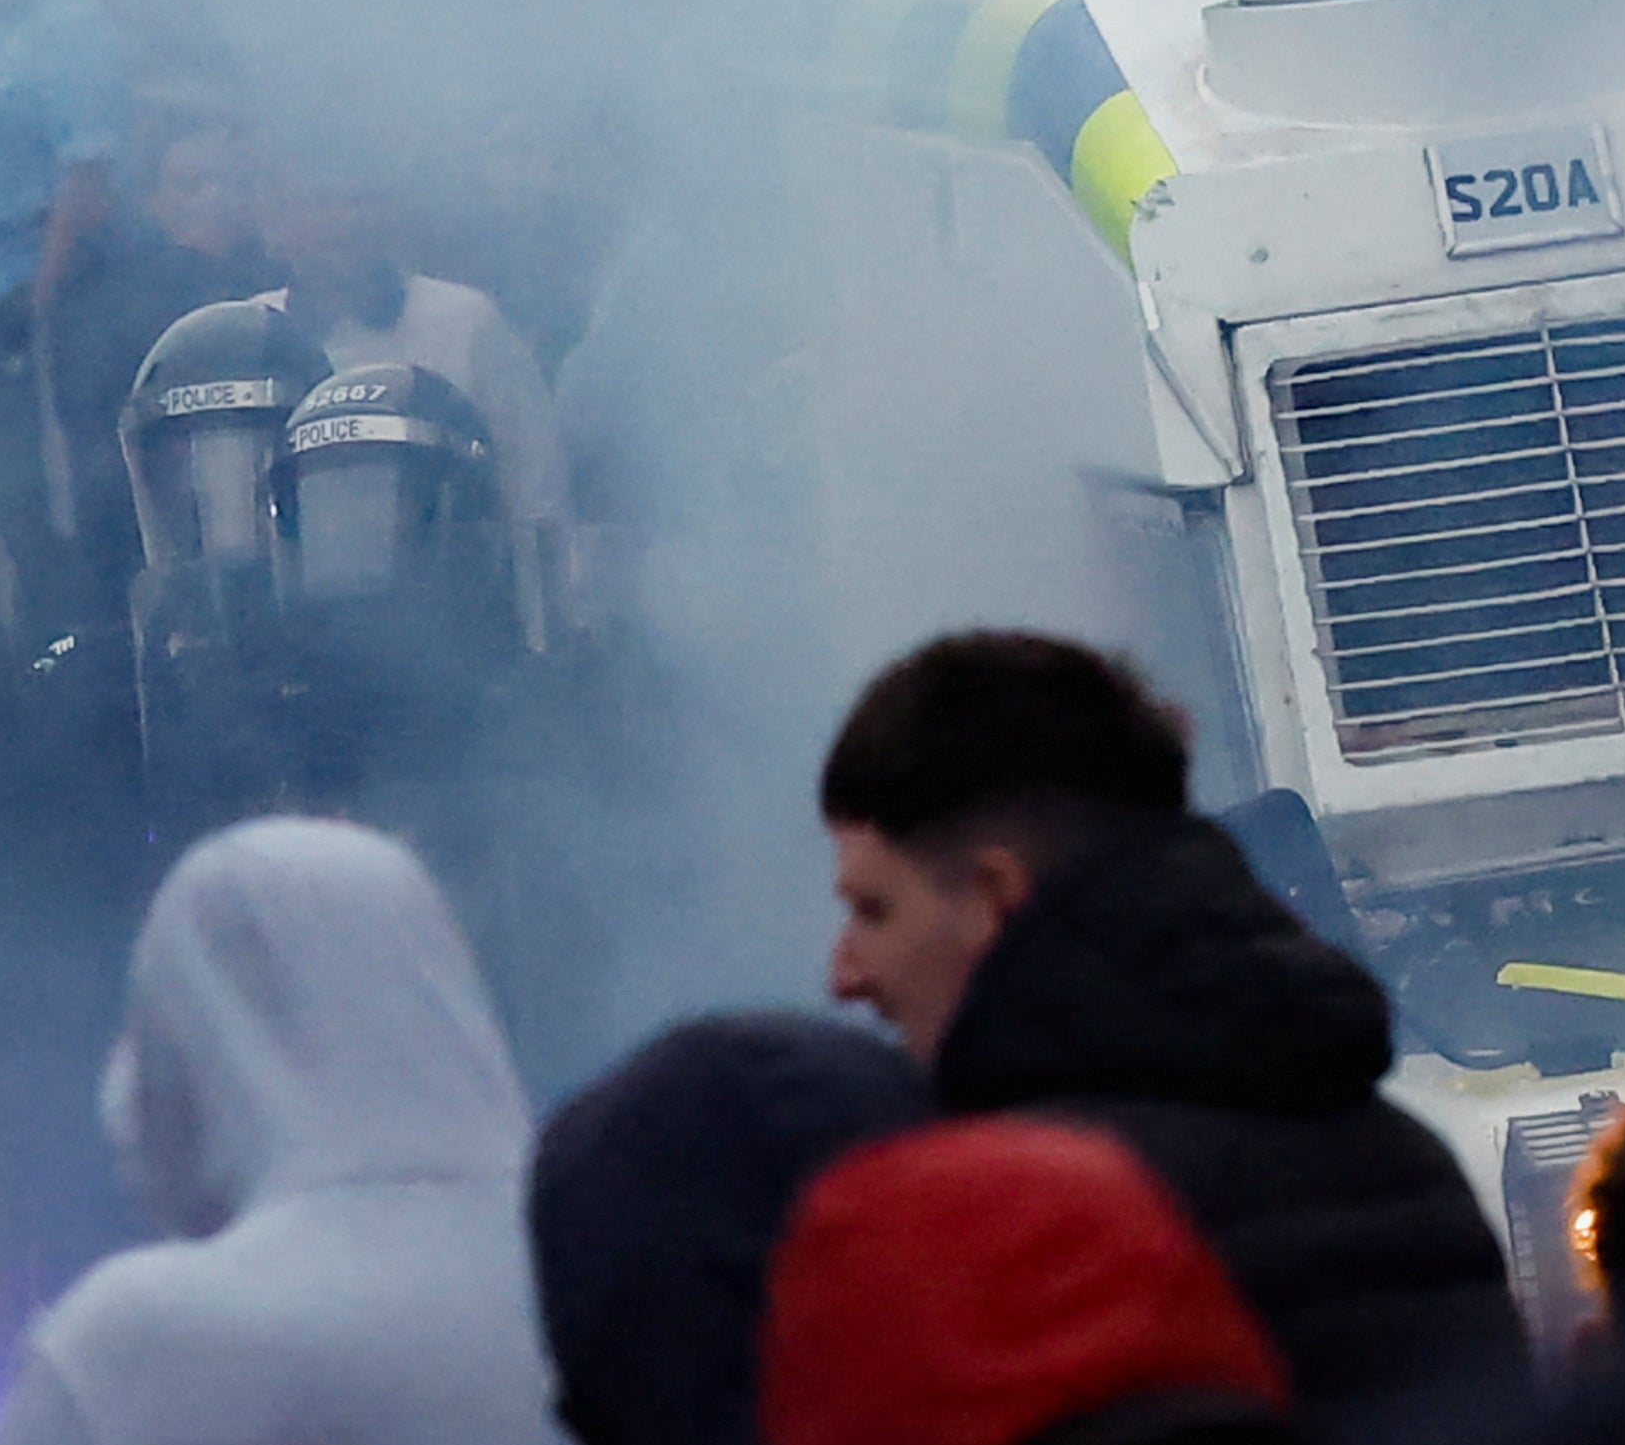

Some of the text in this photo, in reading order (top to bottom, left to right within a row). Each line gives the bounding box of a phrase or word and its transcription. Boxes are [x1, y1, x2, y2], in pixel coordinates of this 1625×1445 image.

[1445, 159, 1599, 222] S20A
[171, 386, 236, 412] POLICE
[299, 419, 362, 446] POLICE
